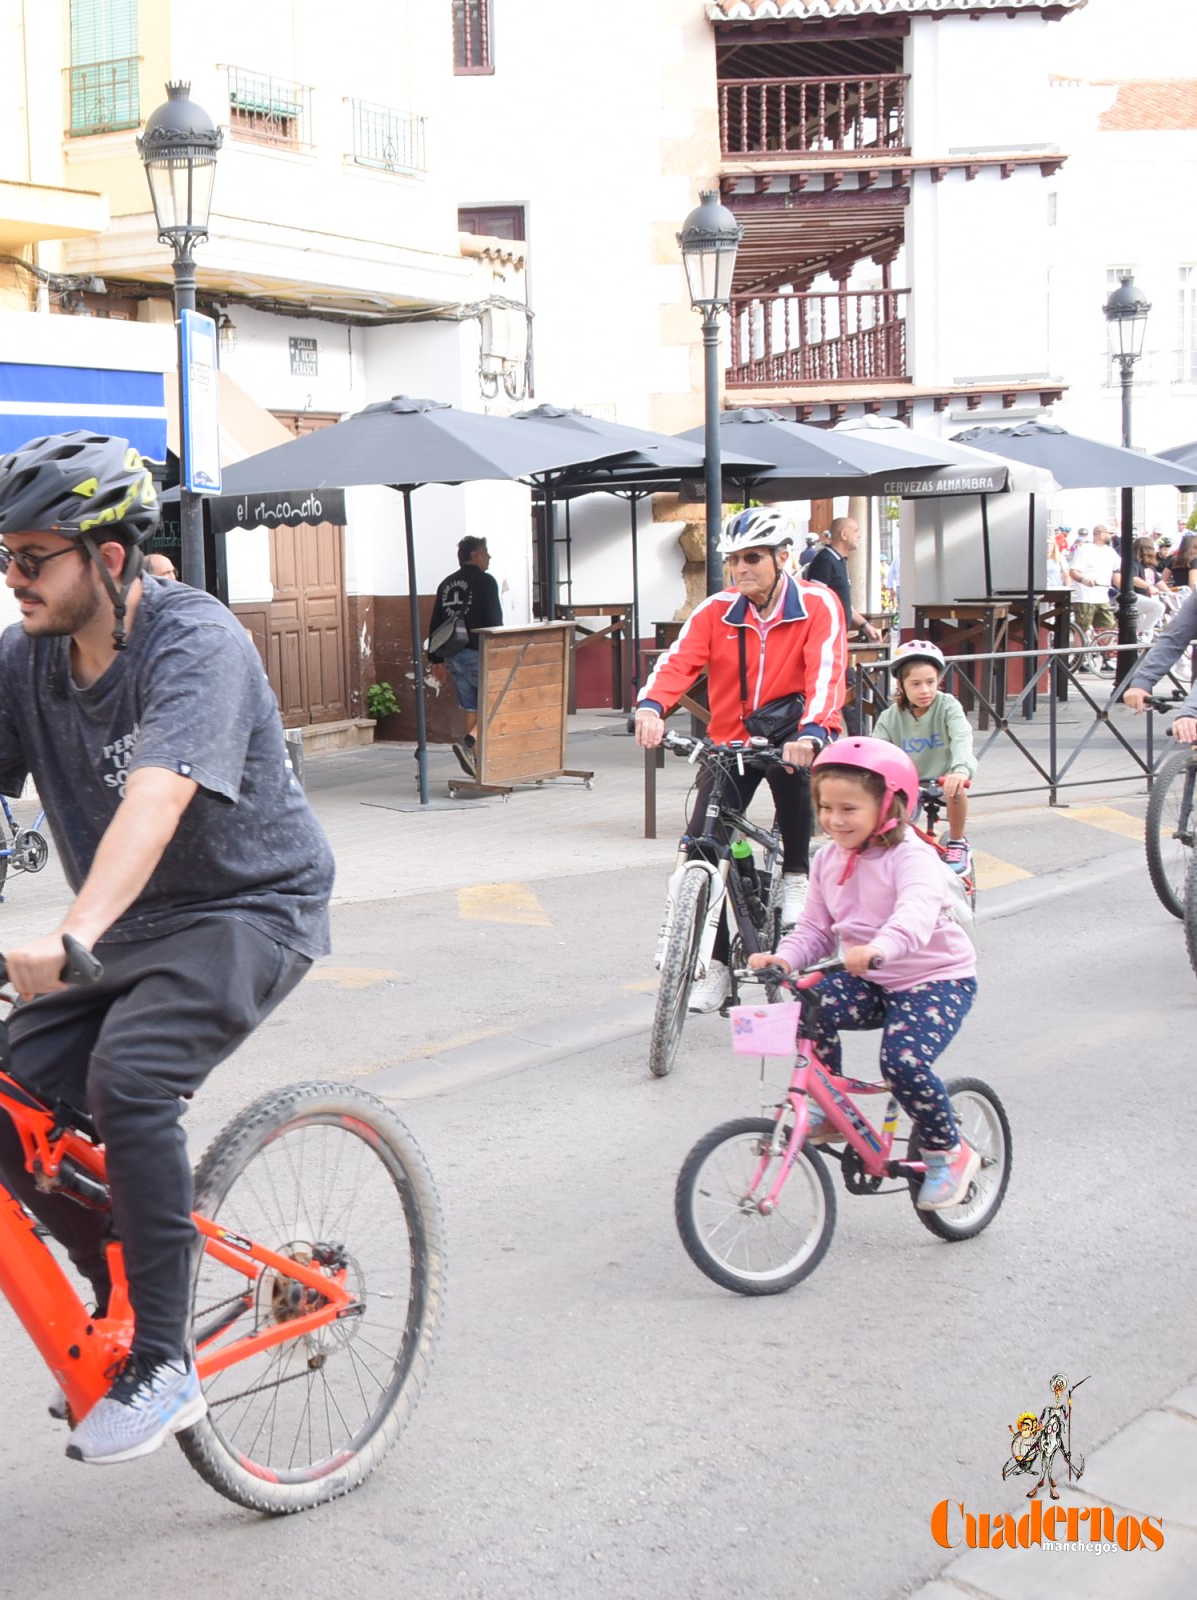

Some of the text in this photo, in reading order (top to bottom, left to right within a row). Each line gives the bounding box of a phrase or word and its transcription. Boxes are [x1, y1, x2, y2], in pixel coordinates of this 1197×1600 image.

[297, 339, 314, 349] CALLE
[883, 476, 994, 494] CERVEZAS ALHAMBRA
[236, 491, 323, 522] el rinconcito
